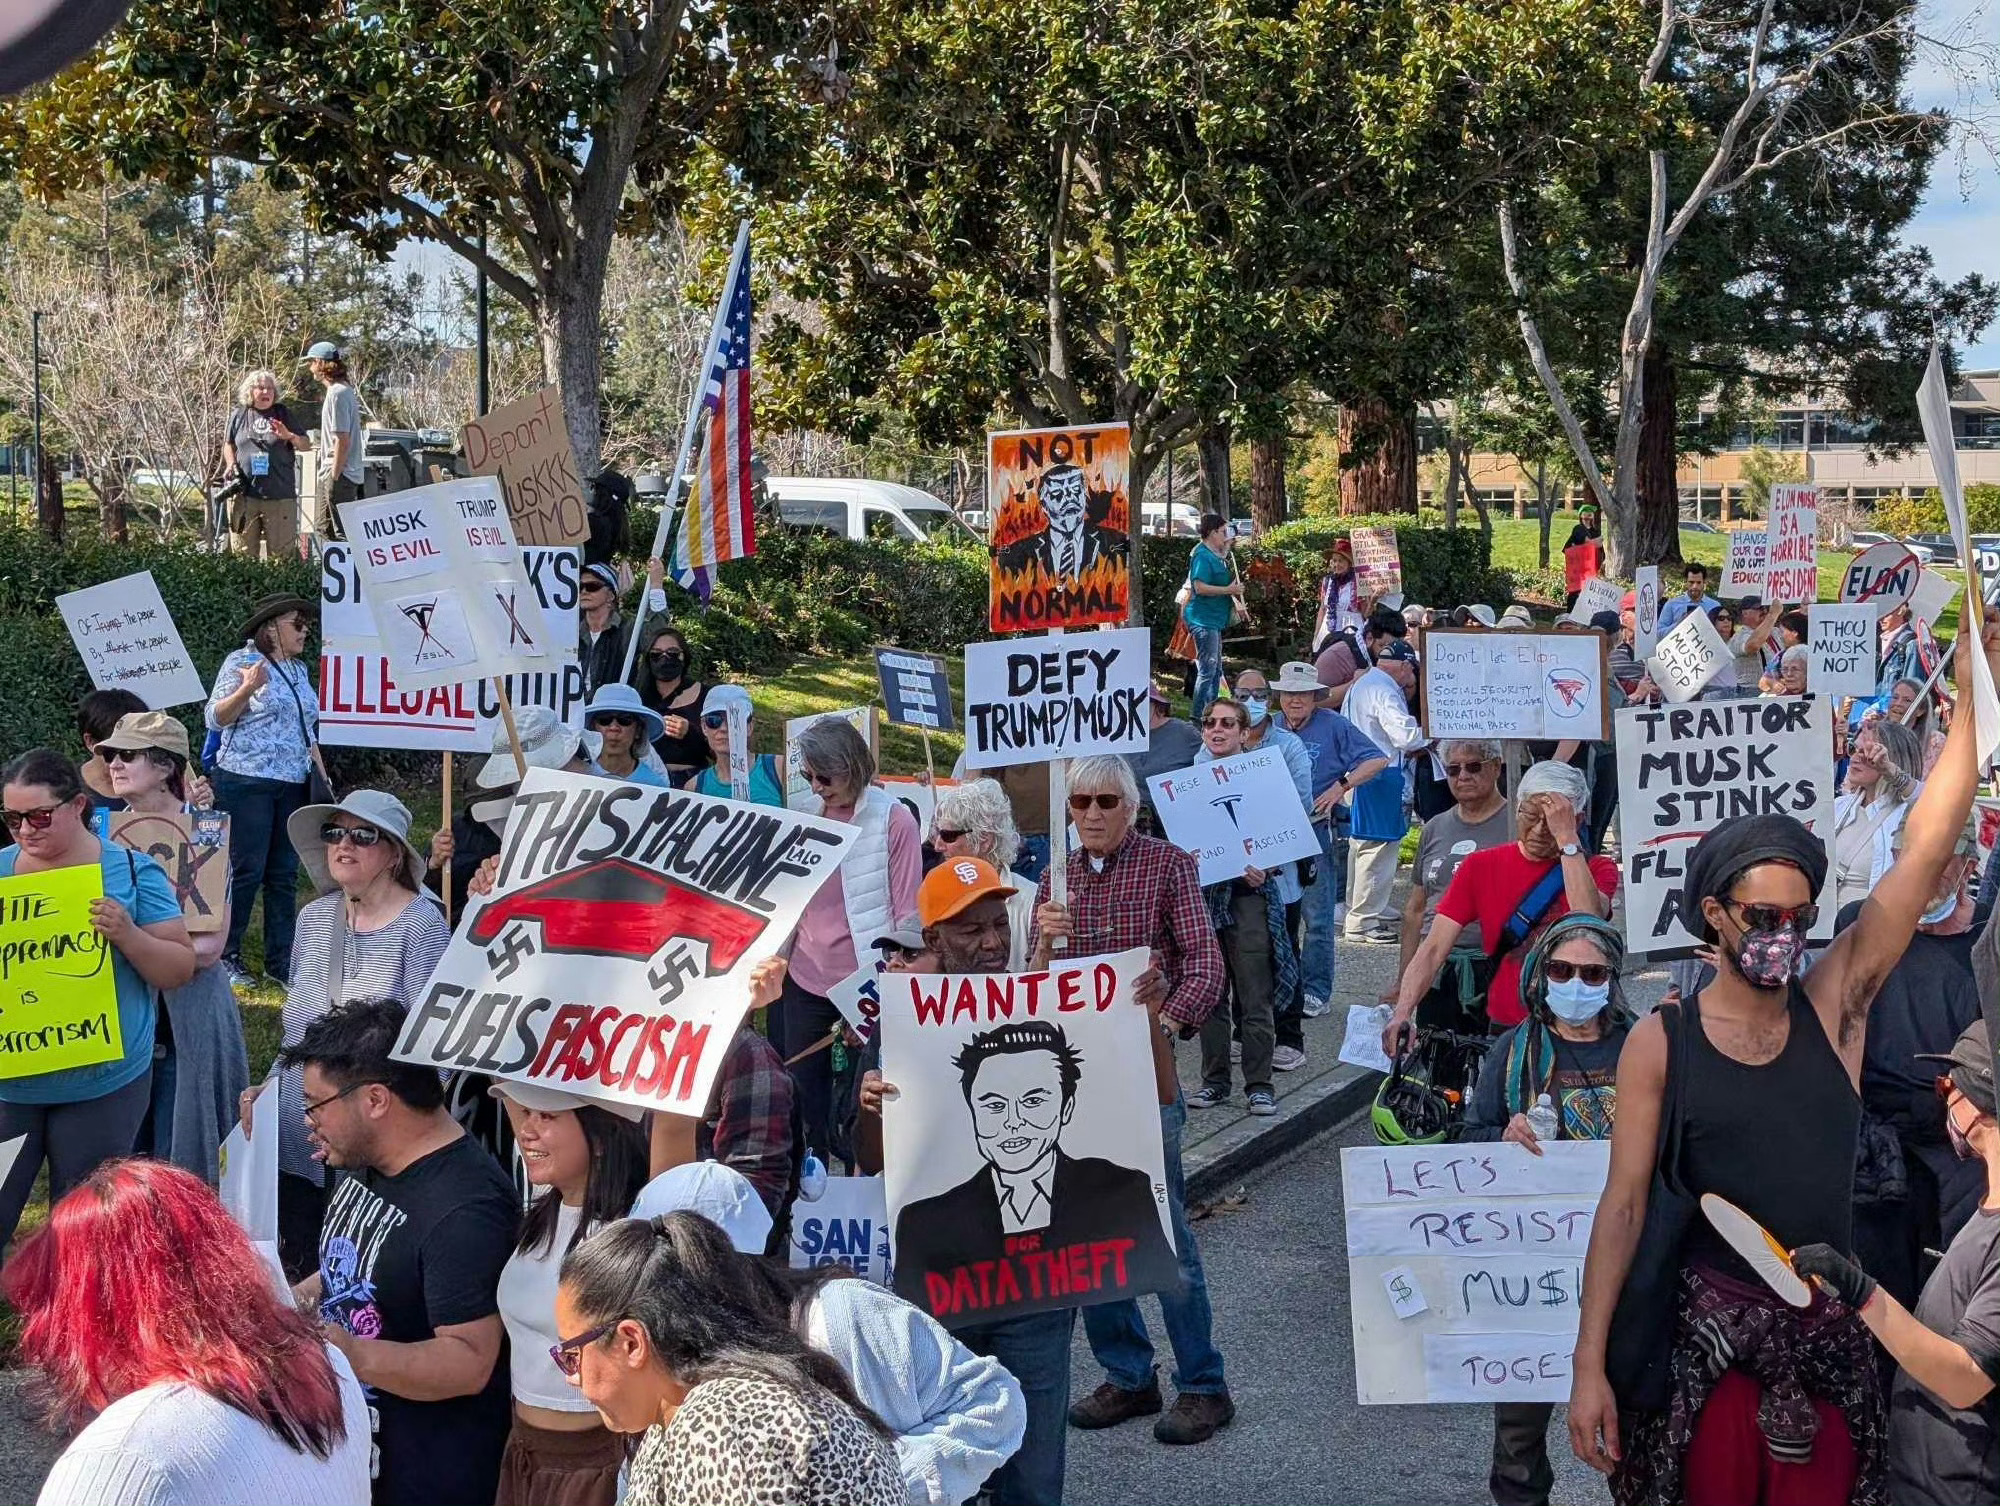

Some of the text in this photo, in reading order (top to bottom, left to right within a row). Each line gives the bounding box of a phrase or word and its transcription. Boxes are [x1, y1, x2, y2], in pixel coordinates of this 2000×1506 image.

[464, 393, 553, 470] Deport
[1018, 432, 1100, 471] NOT
[456, 499, 497, 519] TRUMP
[1776, 488, 1796, 511] ELON
[364, 510, 427, 540] MUSK
[466, 527, 507, 547] IS EVIL
[1733, 533, 1767, 545] HANDS
[1780, 512, 1798, 536] IS A
[367, 538, 441, 567] IS EVIL
[1732, 546, 1751, 557] OUR
[1732, 558, 1745, 569] NO
[1770, 533, 1813, 565] HORRIBLE
[1766, 566, 1817, 599] PRESIDENT
[1846, 566, 1910, 597] ELON
[122, 609, 137, 625] the
[1000, 583, 1122, 624] NORMAL
[1686, 622, 1713, 664] THIS
[1819, 620, 1866, 638] THOU
[90, 647, 105, 664] By
[134, 637, 147, 650] the
[148, 632, 171, 652] people
[1517, 646, 1559, 665] Elon
[1670, 632, 1705, 680] MUSK
[1812, 640, 1869, 654] MUSK
[100, 669, 114, 683] For
[1007, 648, 1121, 697] DEFY
[1658, 648, 1690, 688] STOP
[1823, 657, 1859, 673] NOT
[1434, 686, 1477, 696] SOCIAL
[969, 687, 1149, 753] TRUMP/MUSK
[1436, 708, 1496, 720] EDUCATION
[1439, 722, 1484, 731] NATIONAL
[1635, 701, 1812, 744] TRAITOR
[1159, 756, 1273, 802] THESE MACHINES
[1638, 743, 1779, 790] MUSK
[1653, 779, 1817, 827] STINKS
[497, 786, 844, 913] THIS MACHINE
[786, 844, 822, 866] LALO
[1243, 829, 1297, 856] FASCISTS
[20, 987, 39, 1005] is
[909, 962, 1117, 1028] WANTED
[400, 982, 712, 1102] FUELS FASCISM
[1383, 1156, 1497, 1198] LET'S
[801, 1217, 872, 1255] SAN
[1409, 1210, 1594, 1248] RESIST
[925, 1237, 1136, 1318] DATA THEFT
